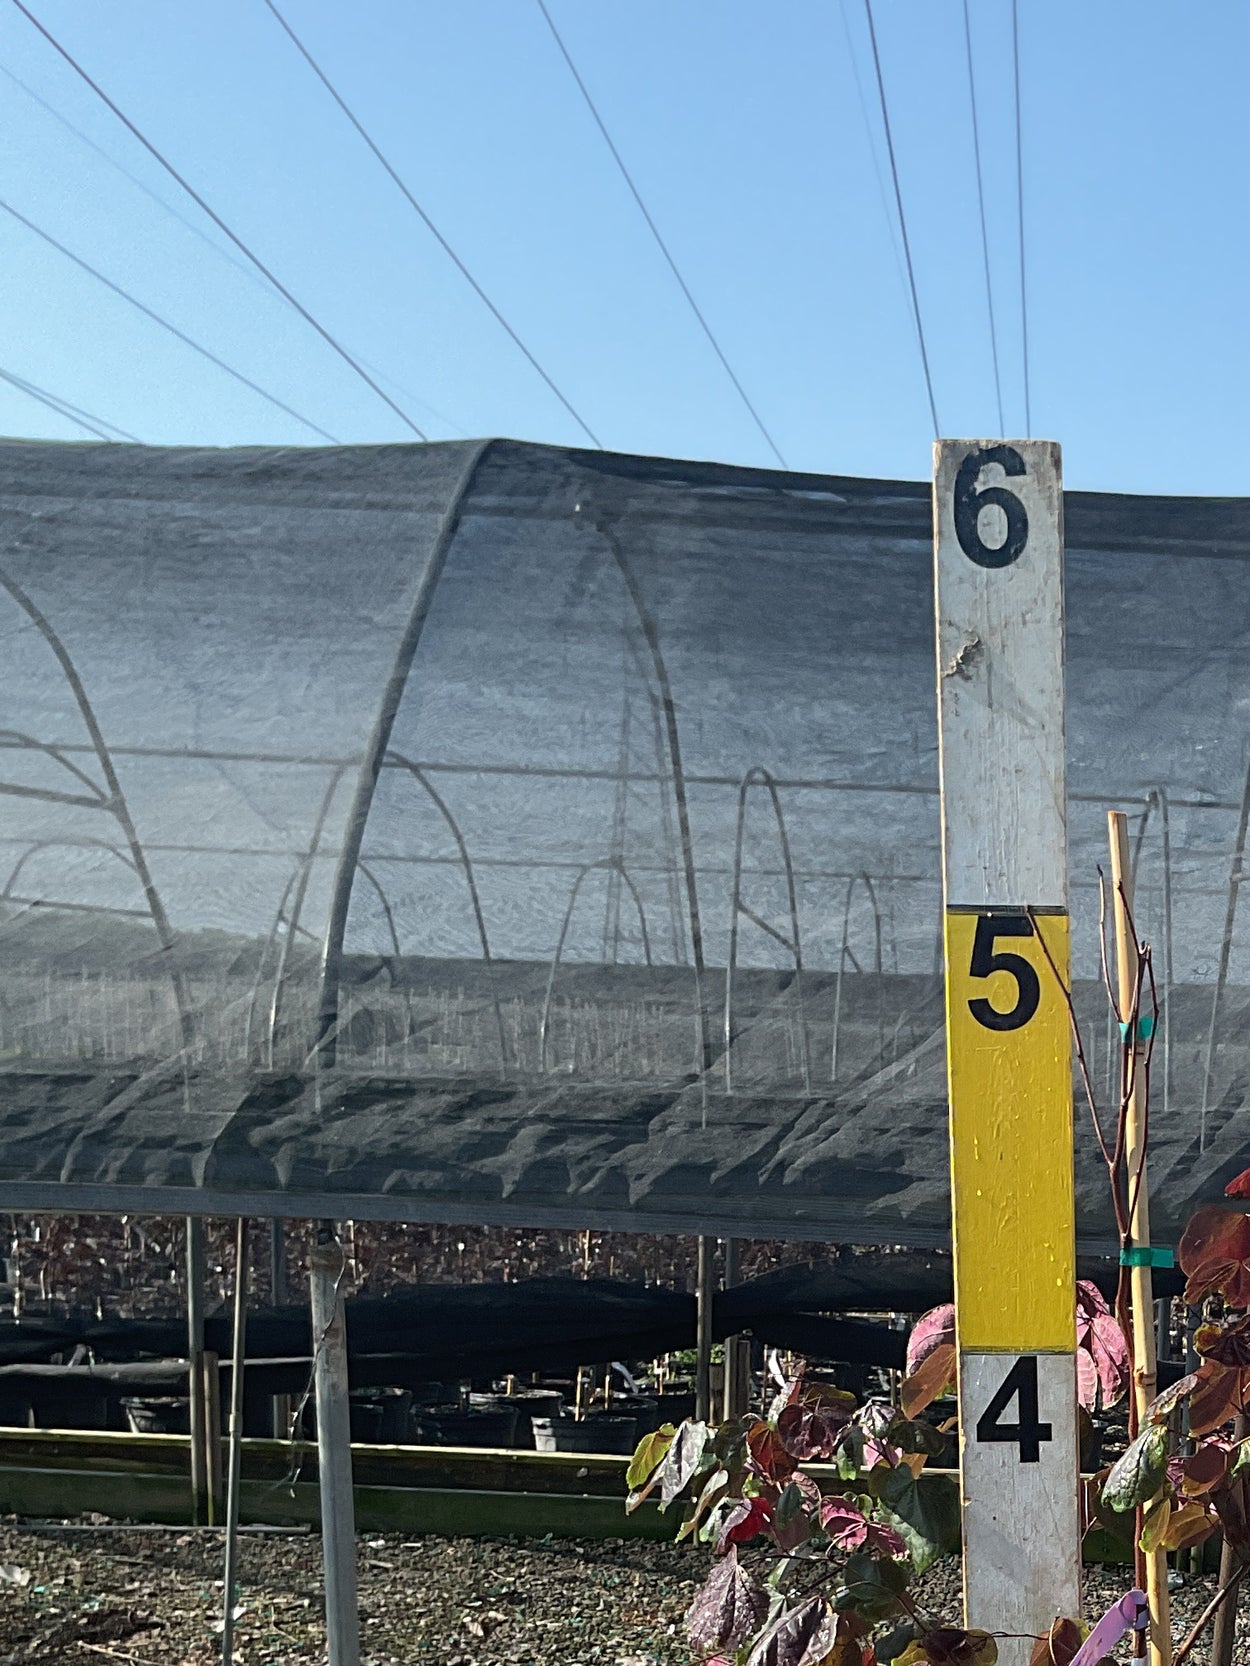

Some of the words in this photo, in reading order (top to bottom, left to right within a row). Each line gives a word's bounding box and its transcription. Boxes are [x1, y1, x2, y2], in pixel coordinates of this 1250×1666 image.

[954, 446, 1028, 568] 6
[967, 914, 1040, 1031] 5
[977, 1355, 1053, 1463] 4
